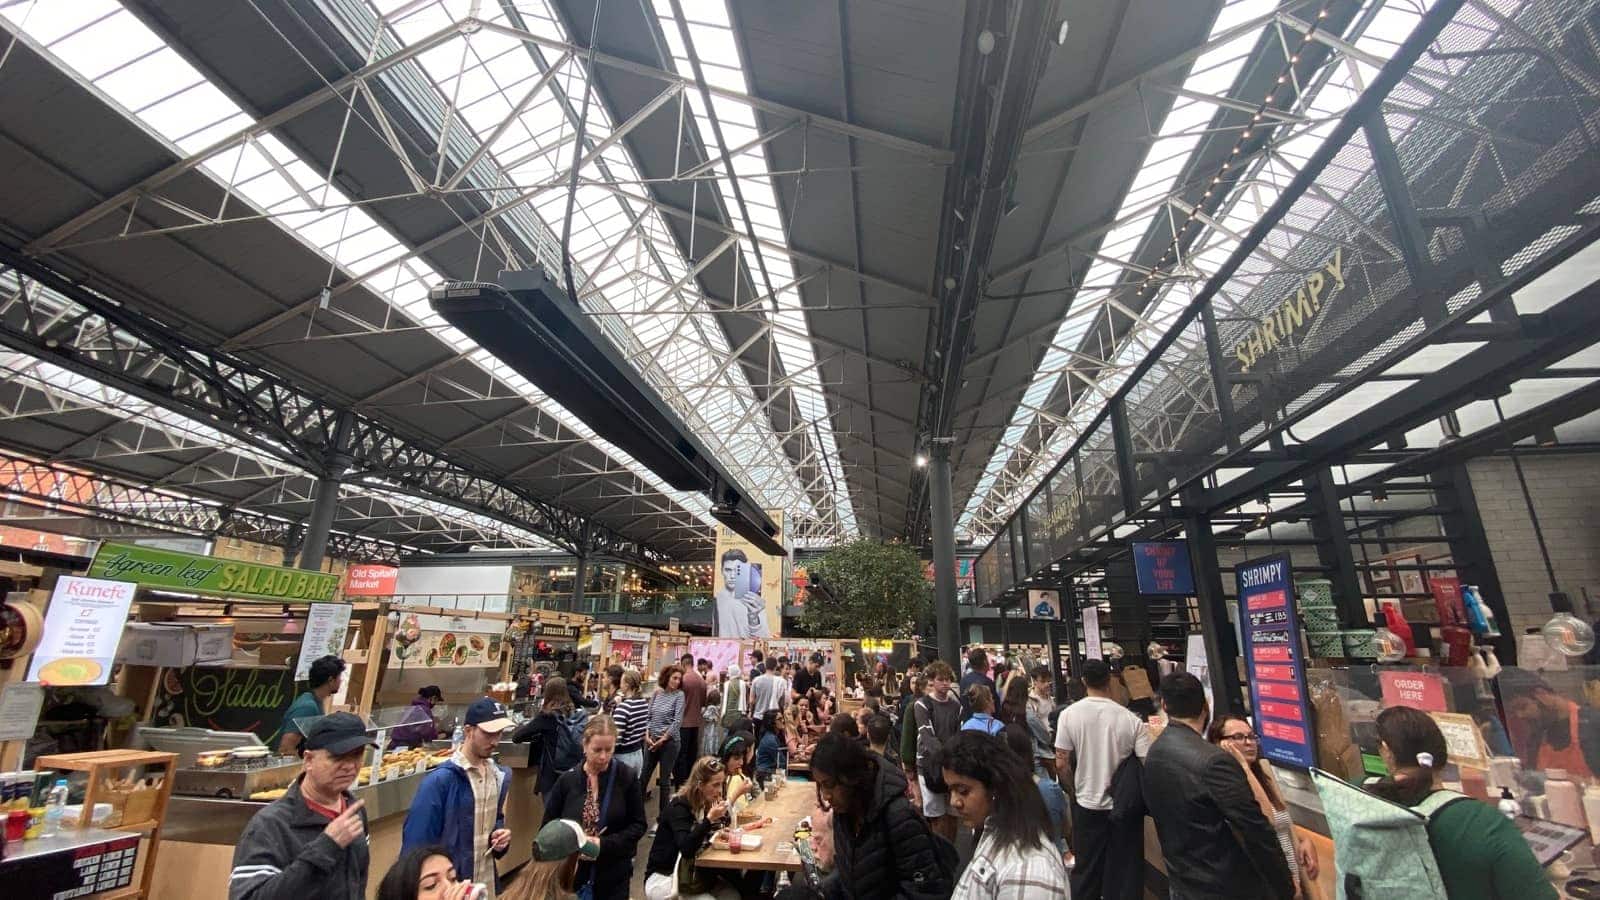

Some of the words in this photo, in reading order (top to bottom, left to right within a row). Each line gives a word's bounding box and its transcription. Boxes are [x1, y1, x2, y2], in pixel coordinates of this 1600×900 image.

[1234, 246, 1345, 374] SHRIMPY
[176, 559, 224, 587] leaf
[219, 563, 290, 597] SALAD
[293, 574, 333, 600] BAR
[352, 569, 367, 578] Old
[1242, 562, 1283, 588] SHRIMPY
[65, 580, 127, 599] Kunefe
[350, 580, 379, 588] Market
[190, 667, 284, 716] Salad
[1393, 679, 1425, 690] ORDER
[1399, 690, 1424, 701] HERE
